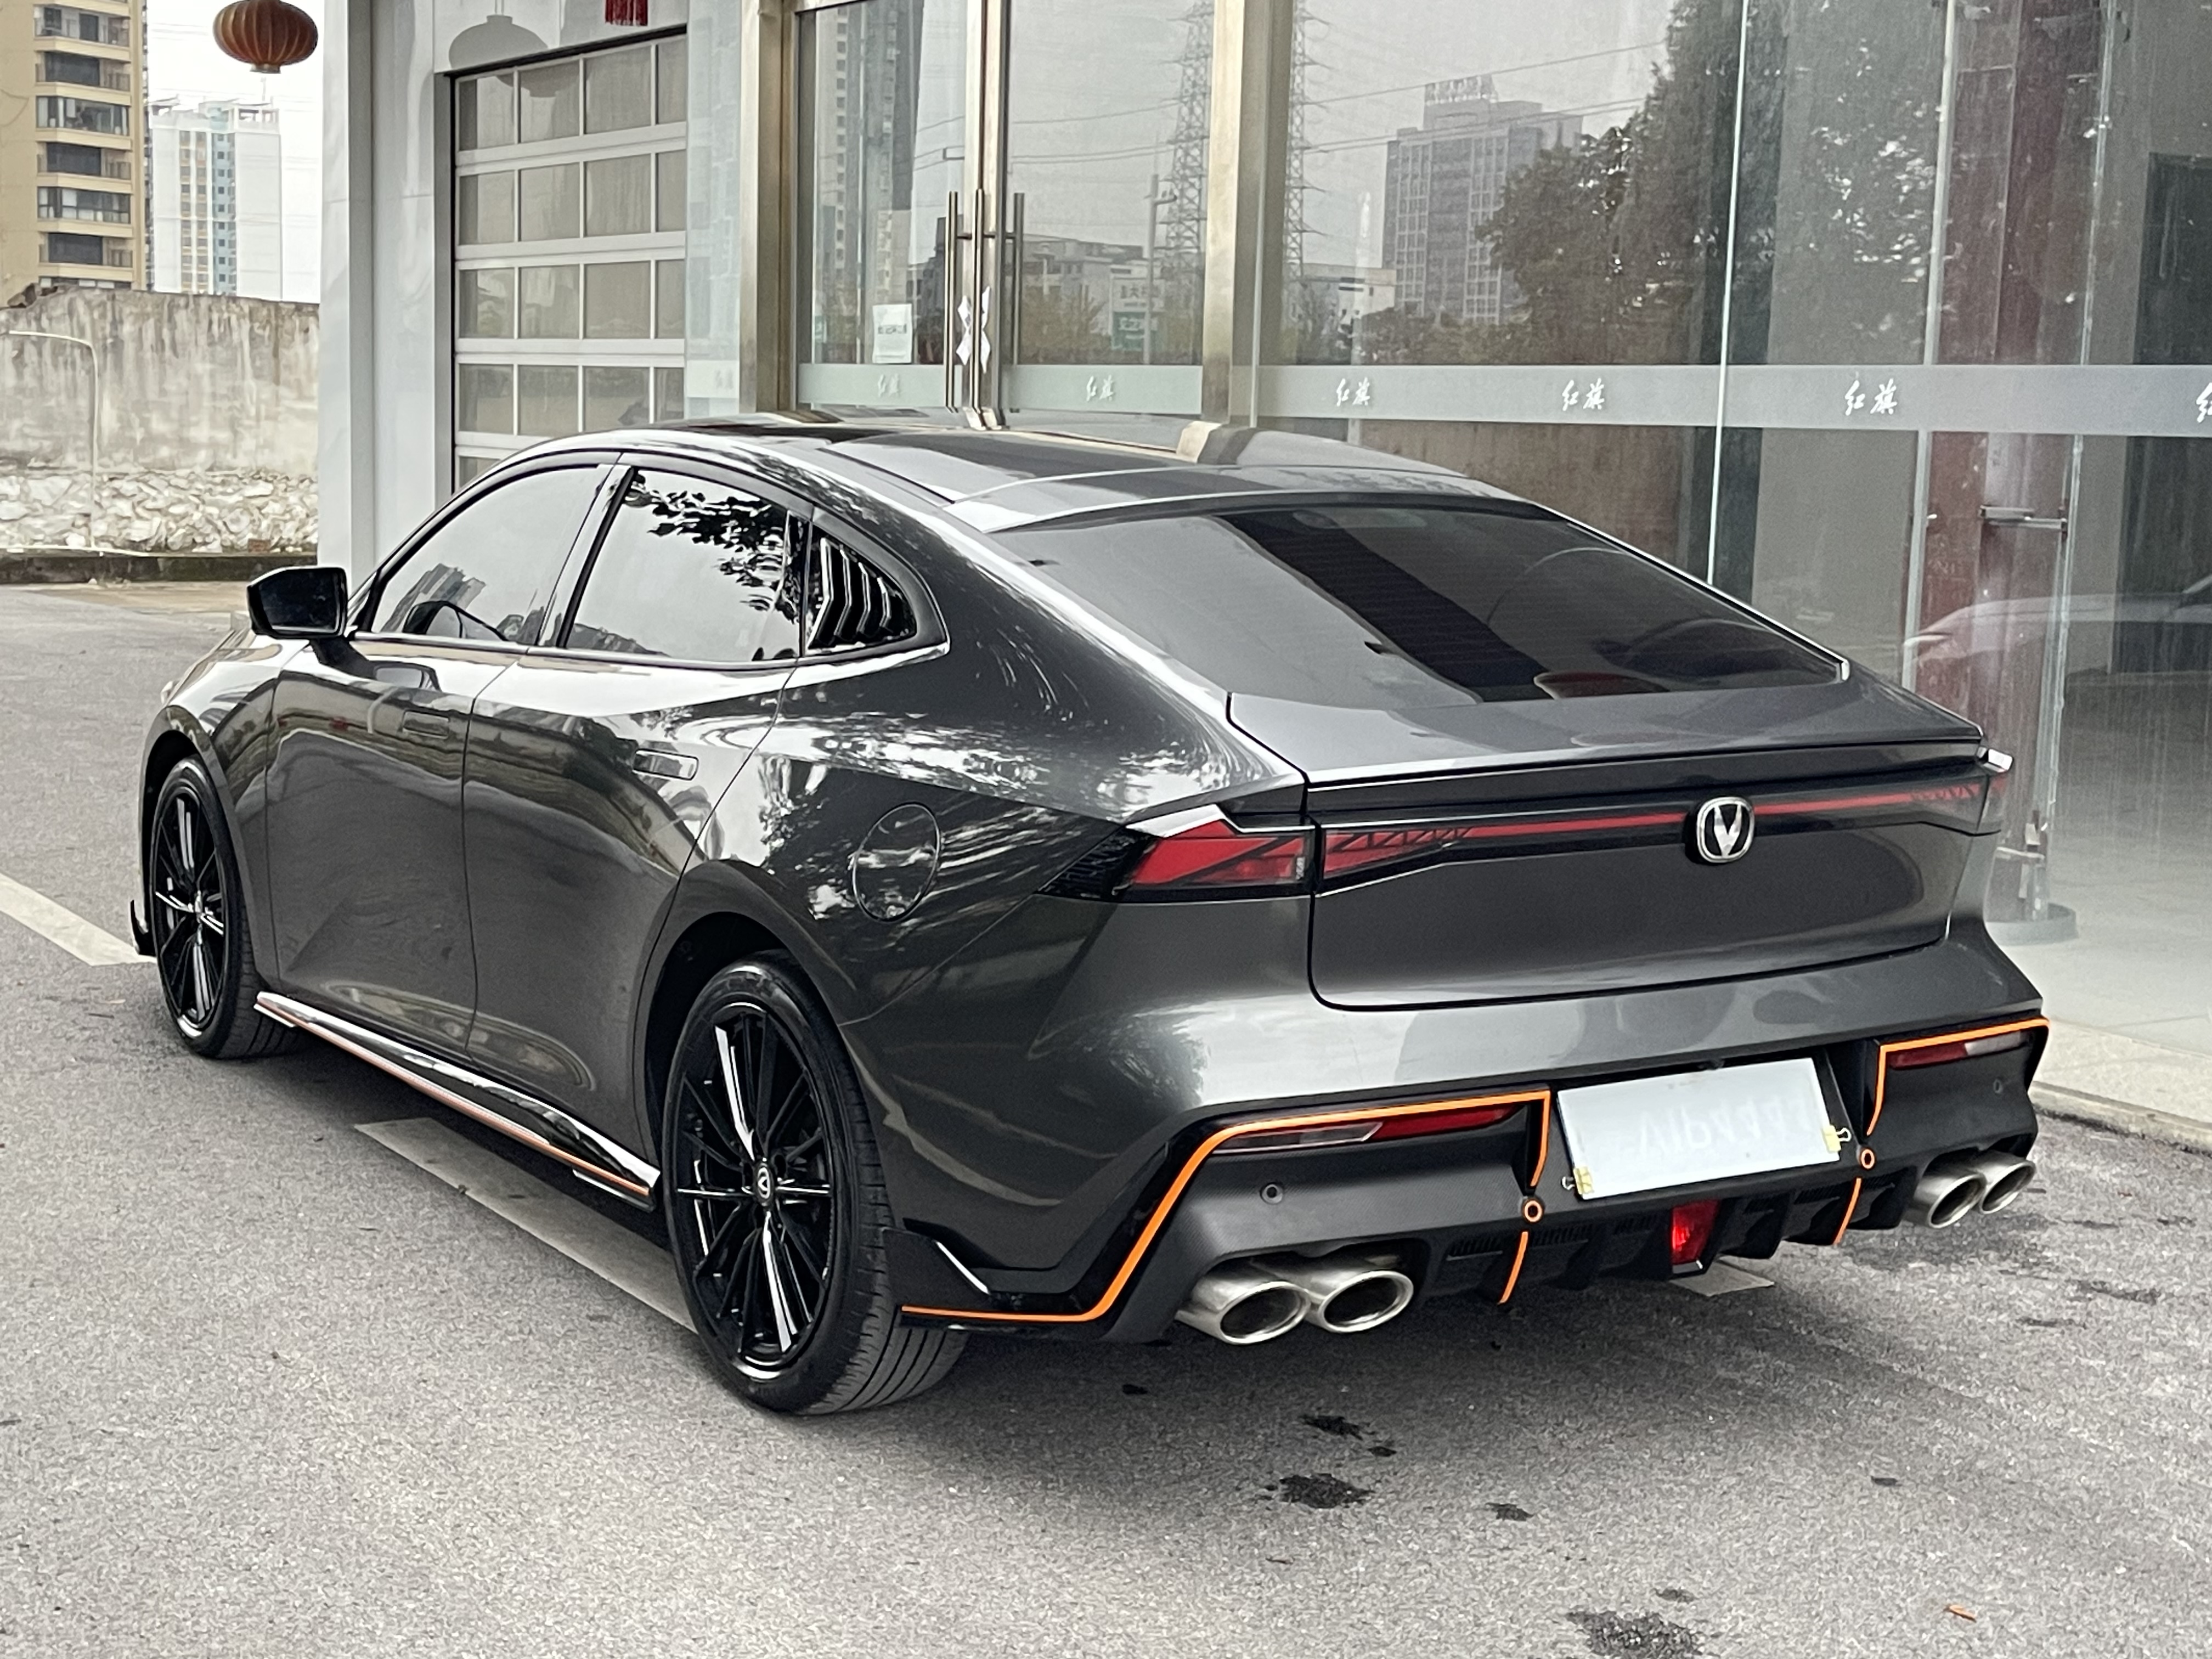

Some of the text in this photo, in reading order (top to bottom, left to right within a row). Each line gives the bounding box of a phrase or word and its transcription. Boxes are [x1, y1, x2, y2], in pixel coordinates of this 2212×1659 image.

[1086, 375, 1113, 401] 红旗
[1336, 377, 1370, 407] 红旗
[1562, 377, 1604, 411] 红旗
[1845, 378, 1897, 416] 红旗
